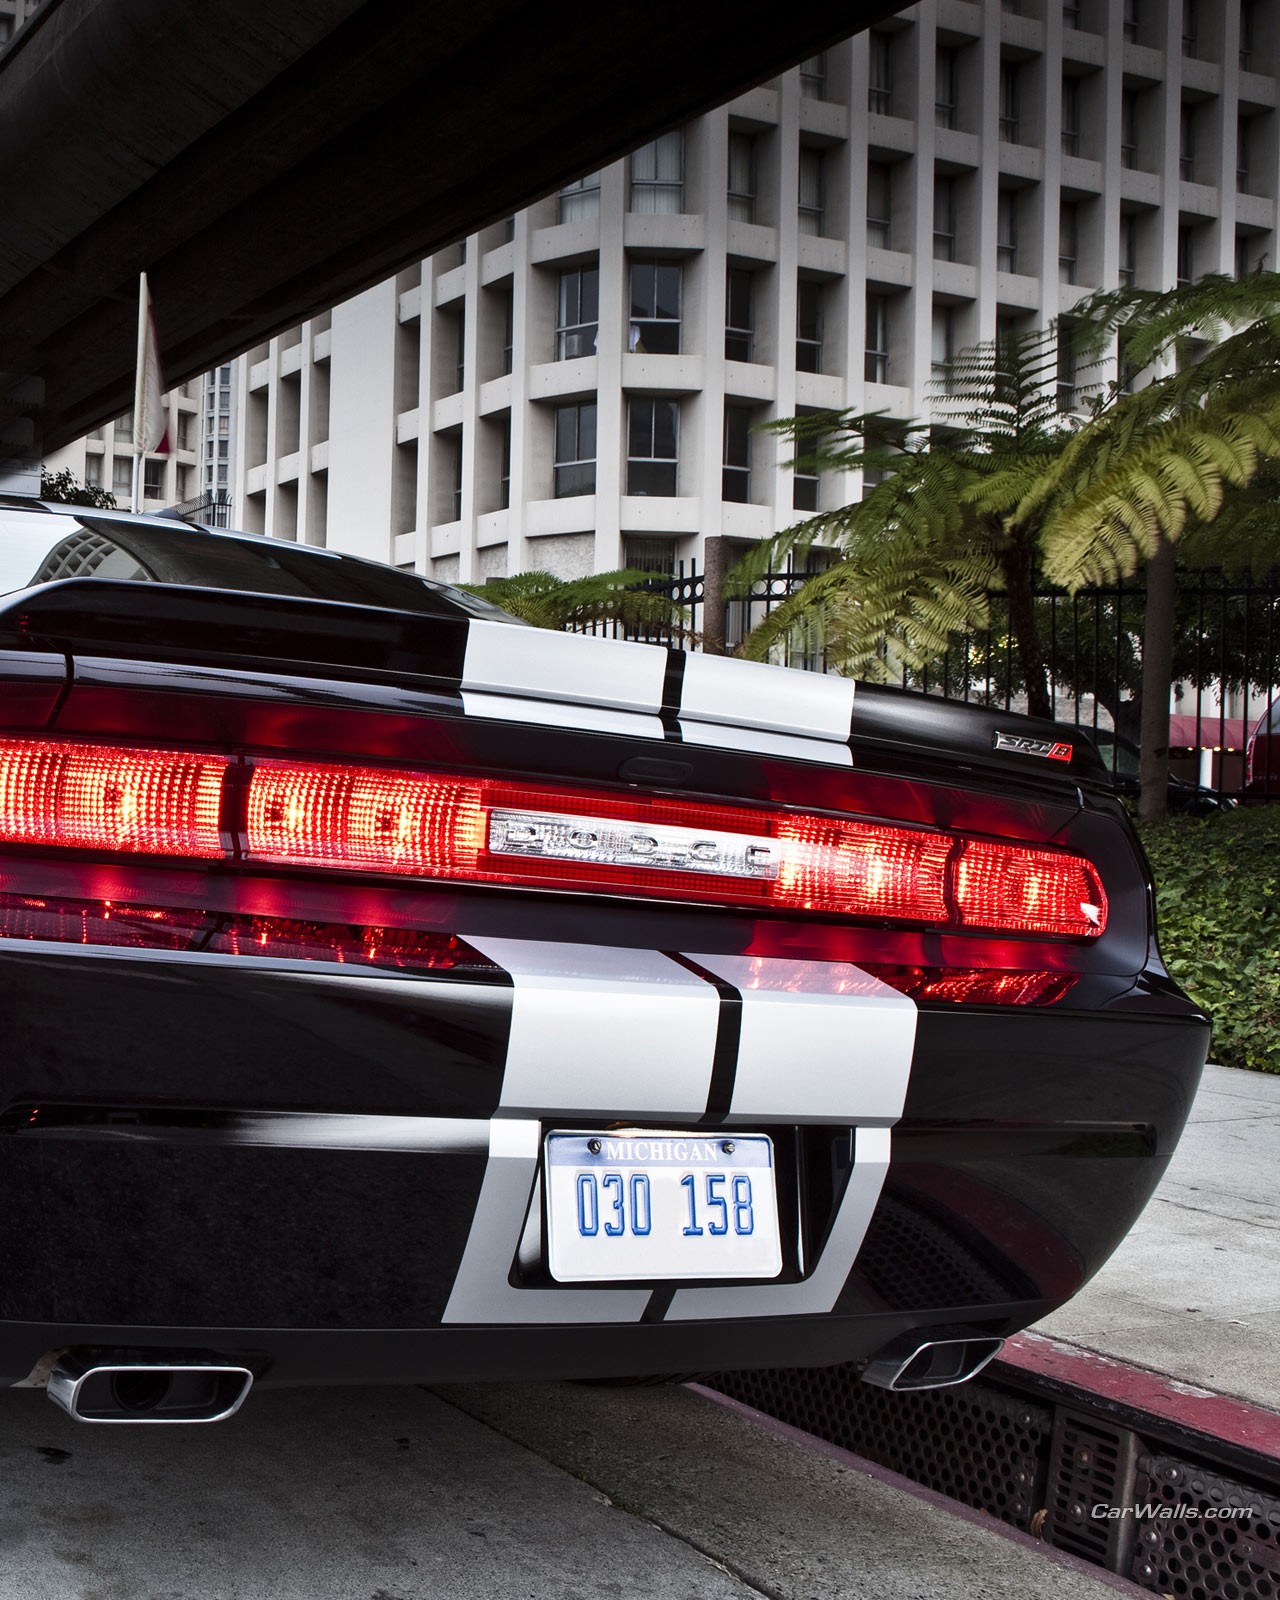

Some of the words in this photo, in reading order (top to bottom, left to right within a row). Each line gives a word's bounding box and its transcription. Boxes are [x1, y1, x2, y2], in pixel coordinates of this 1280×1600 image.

[505, 823, 772, 867] DODGE
[606, 1141, 718, 1161] MICHIGAN
[576, 1172, 652, 1238] 030
[680, 1174, 755, 1237] 158
